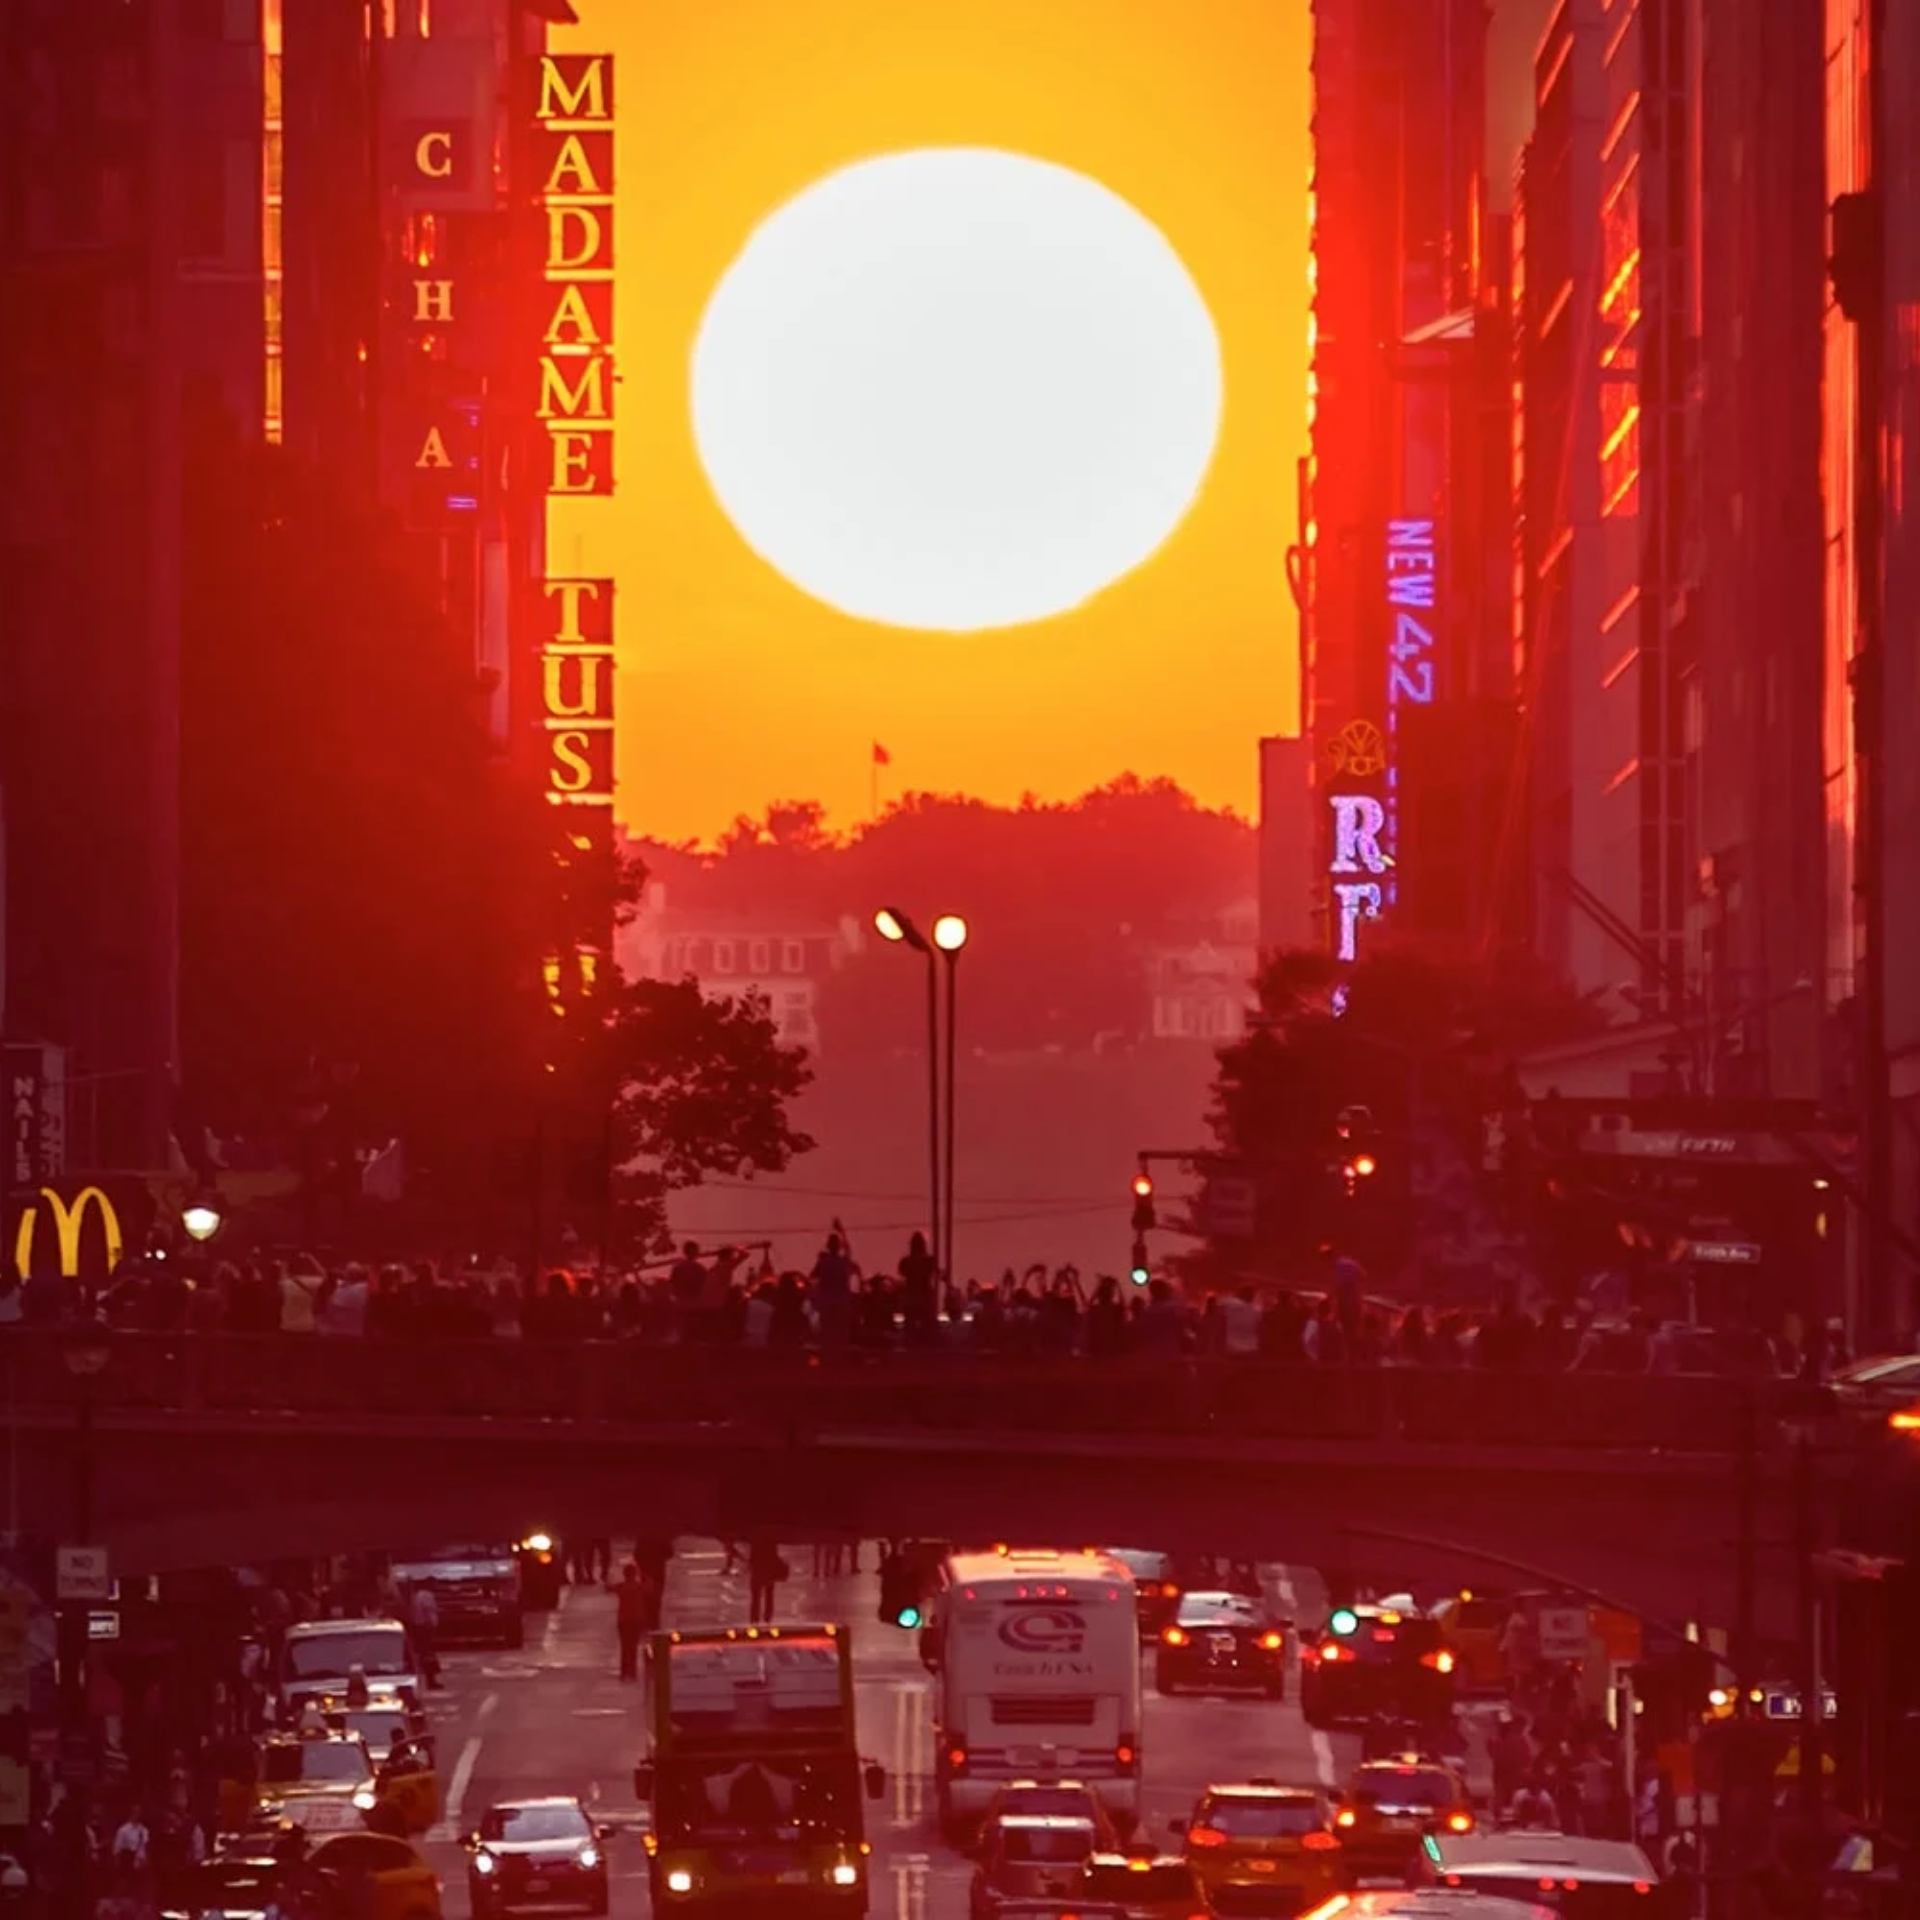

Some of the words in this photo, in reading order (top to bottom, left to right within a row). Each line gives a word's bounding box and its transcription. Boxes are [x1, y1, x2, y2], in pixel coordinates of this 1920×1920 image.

[536, 56, 608, 493] MADAME
[1387, 521, 1434, 607] NEW
[1394, 611, 1434, 704] 42
[541, 581, 602, 866] TUS
